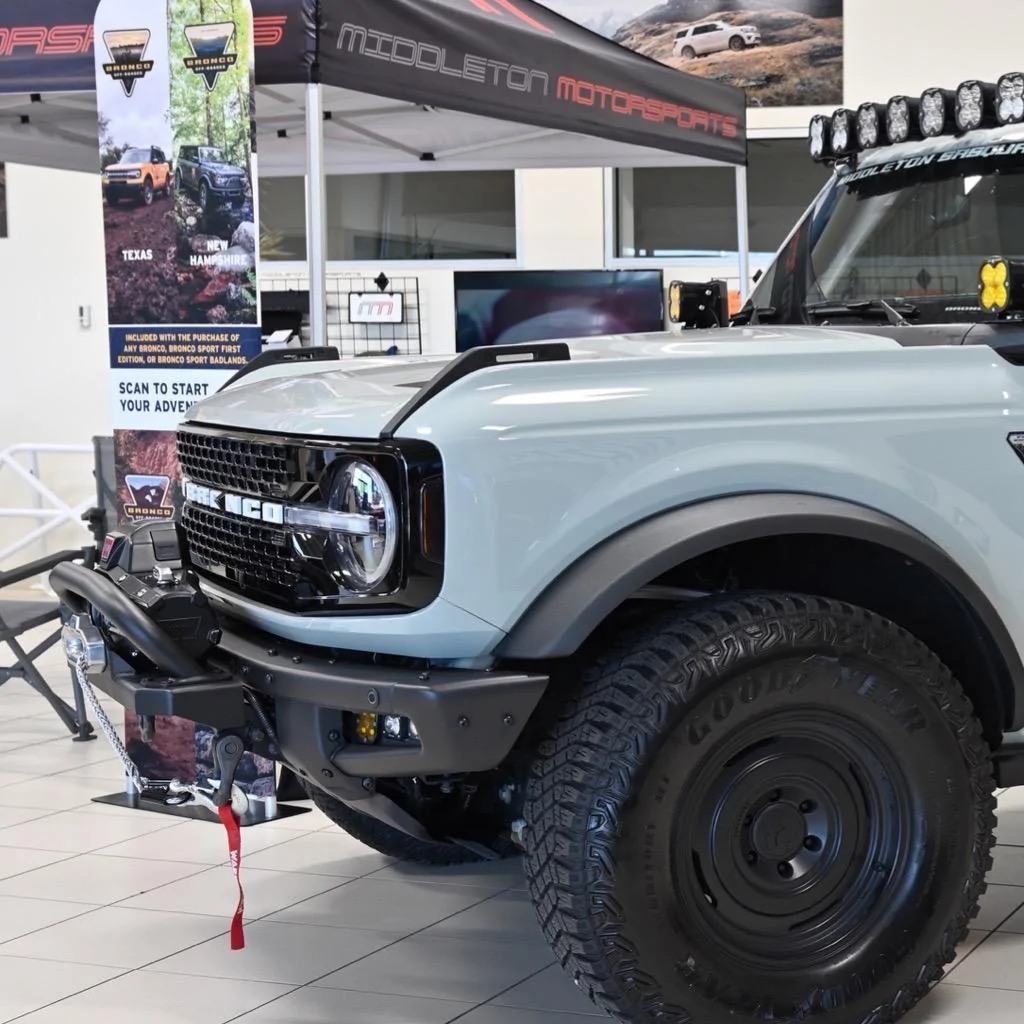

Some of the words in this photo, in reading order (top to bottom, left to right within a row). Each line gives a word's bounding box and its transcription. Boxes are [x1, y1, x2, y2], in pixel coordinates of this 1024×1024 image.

[186, 56, 234, 66] BRONCO
[105, 63, 151, 72] BRONCO
[336, 22, 549, 96] MIDDLETON
[556, 75, 738, 139] MOTORSPORTS
[206, 239, 228, 251] NEW
[122, 249, 153, 261] TEXAS
[189, 254, 248, 266] HAMPSHIRE
[125, 333, 158, 341] INCLUDED
[159, 333, 176, 341] WITH
[178, 333, 191, 341] THE
[193, 333, 229, 341] PURCHASE
[231, 333, 240, 341] OF
[139, 345, 167, 353] BRONCO,
[118, 356, 146, 364] EDITION,
[186, 356, 208, 364] SPORT
[210, 356, 249, 365] BADLANDS.
[119, 382, 149, 394] SCAN
[153, 382, 168, 395] TO
[172, 382, 209, 396] START
[120, 400, 150, 412] YOUR
[127, 507, 171, 516] BRONCO
